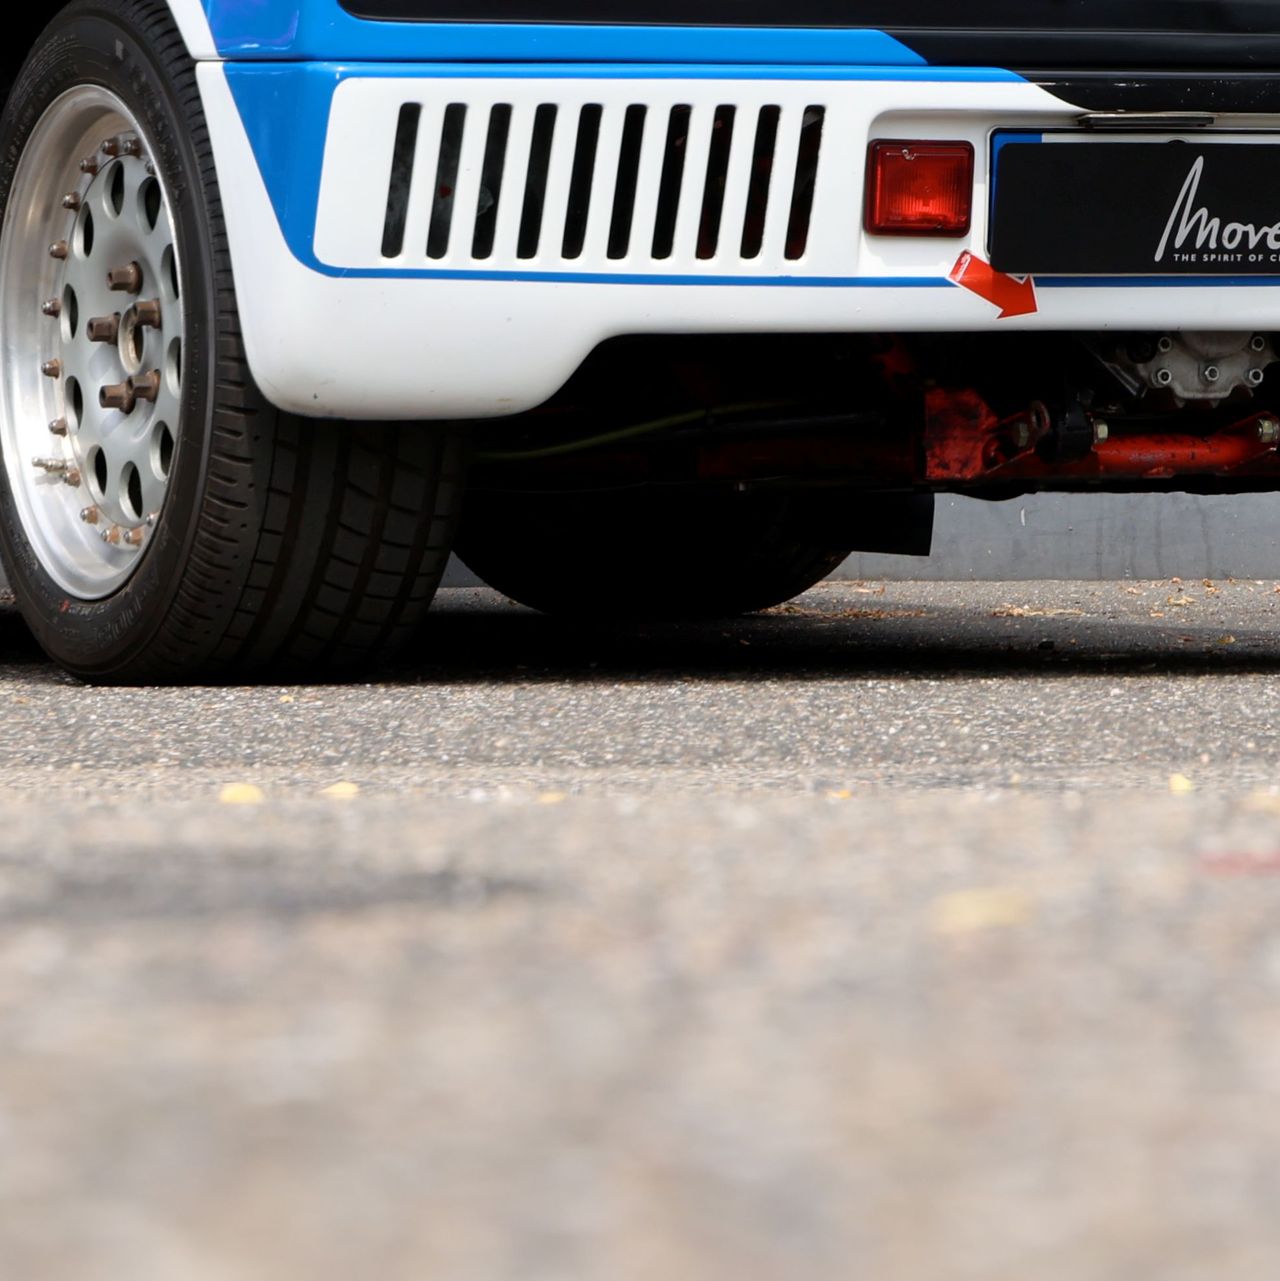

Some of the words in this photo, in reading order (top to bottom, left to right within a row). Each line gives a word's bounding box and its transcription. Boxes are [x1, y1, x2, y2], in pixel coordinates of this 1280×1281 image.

[1173, 253, 1197, 262] THE
[1203, 253, 1242, 262] SPIRIT
[1249, 253, 1264, 262] OF
